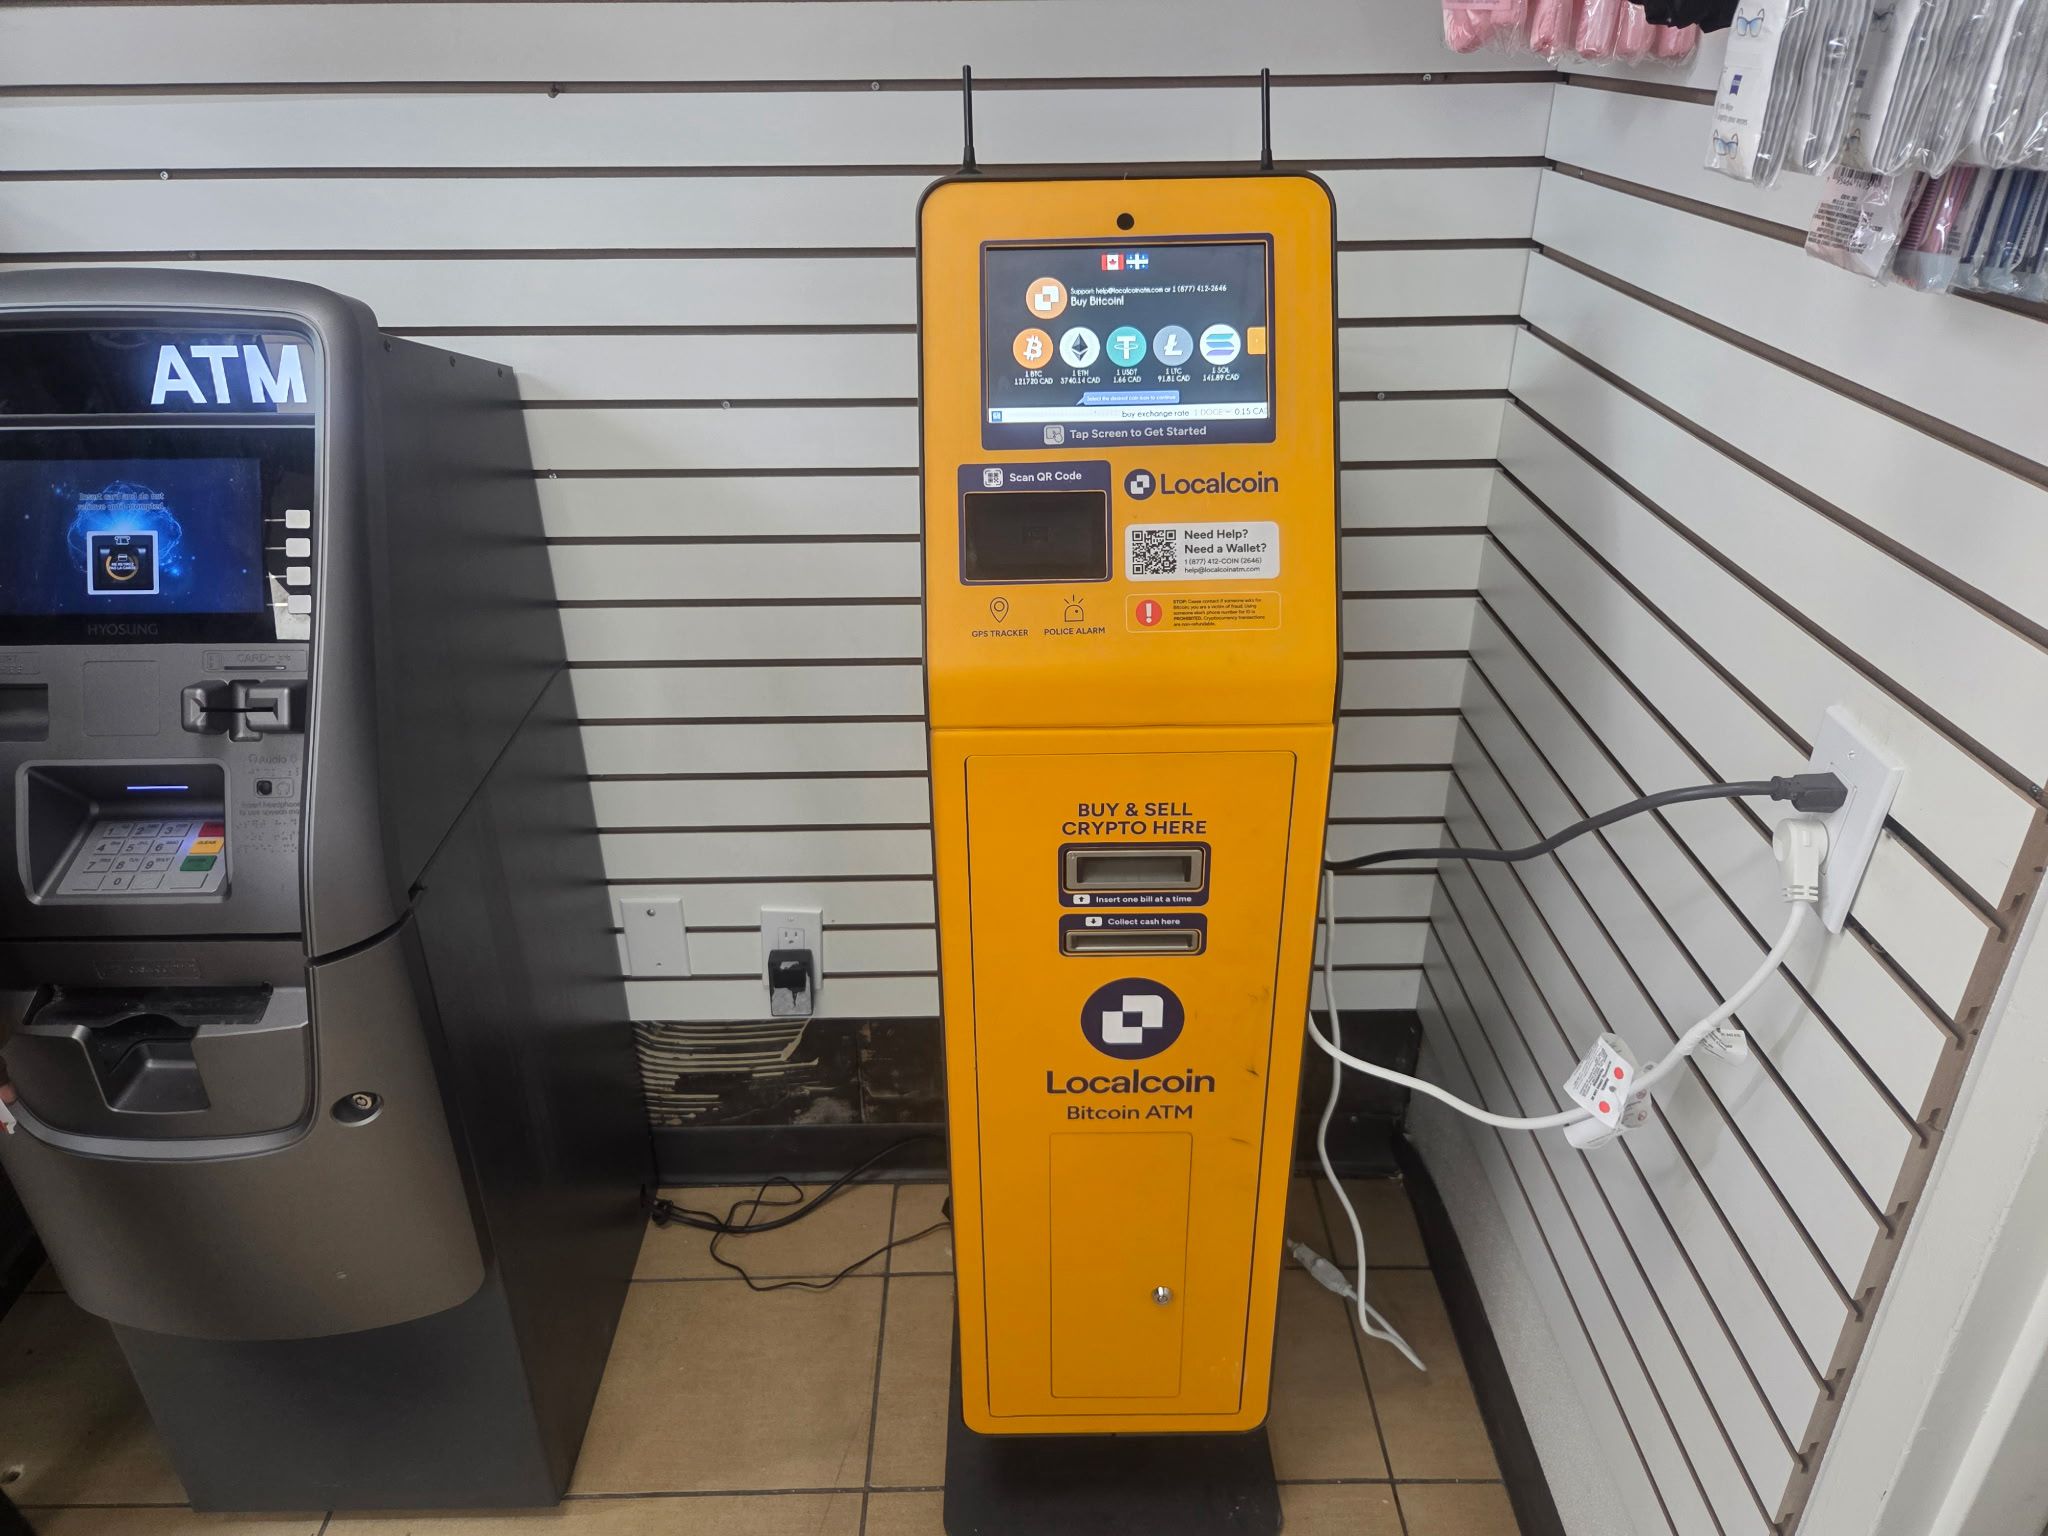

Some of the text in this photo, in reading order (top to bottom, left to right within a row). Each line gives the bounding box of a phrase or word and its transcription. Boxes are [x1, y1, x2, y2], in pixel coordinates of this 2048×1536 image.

[1096, 286, 1163, 295] help@localcoinatm.com
[1071, 295, 1124, 307] Buy Bitcoin!
[150, 344, 308, 405] ATM
[1070, 426, 1206, 441] Tap Screen to Get Started
[1010, 471, 1082, 482] Scan QR Code
[1161, 471, 1278, 494] Localcoin
[128, 503, 164, 511] prompted
[1184, 529, 1248, 540] Need Help?
[1184, 544, 1214, 554] Need
[1226, 543, 1266, 553] Wallet?
[88, 624, 158, 636] HYOSUNG
[259, 754, 287, 764] Audio
[1078, 802, 1193, 817] BUY & SELL
[1062, 820, 1207, 836] CRYPTO HERE
[86, 862, 95, 870] 7
[116, 861, 125, 869] 8
[145, 861, 154, 869] 9
[114, 877, 122, 885] 0
[1046, 1068, 1215, 1094] Localcoin
[1067, 1104, 1193, 1120] Bitcoin ATM
